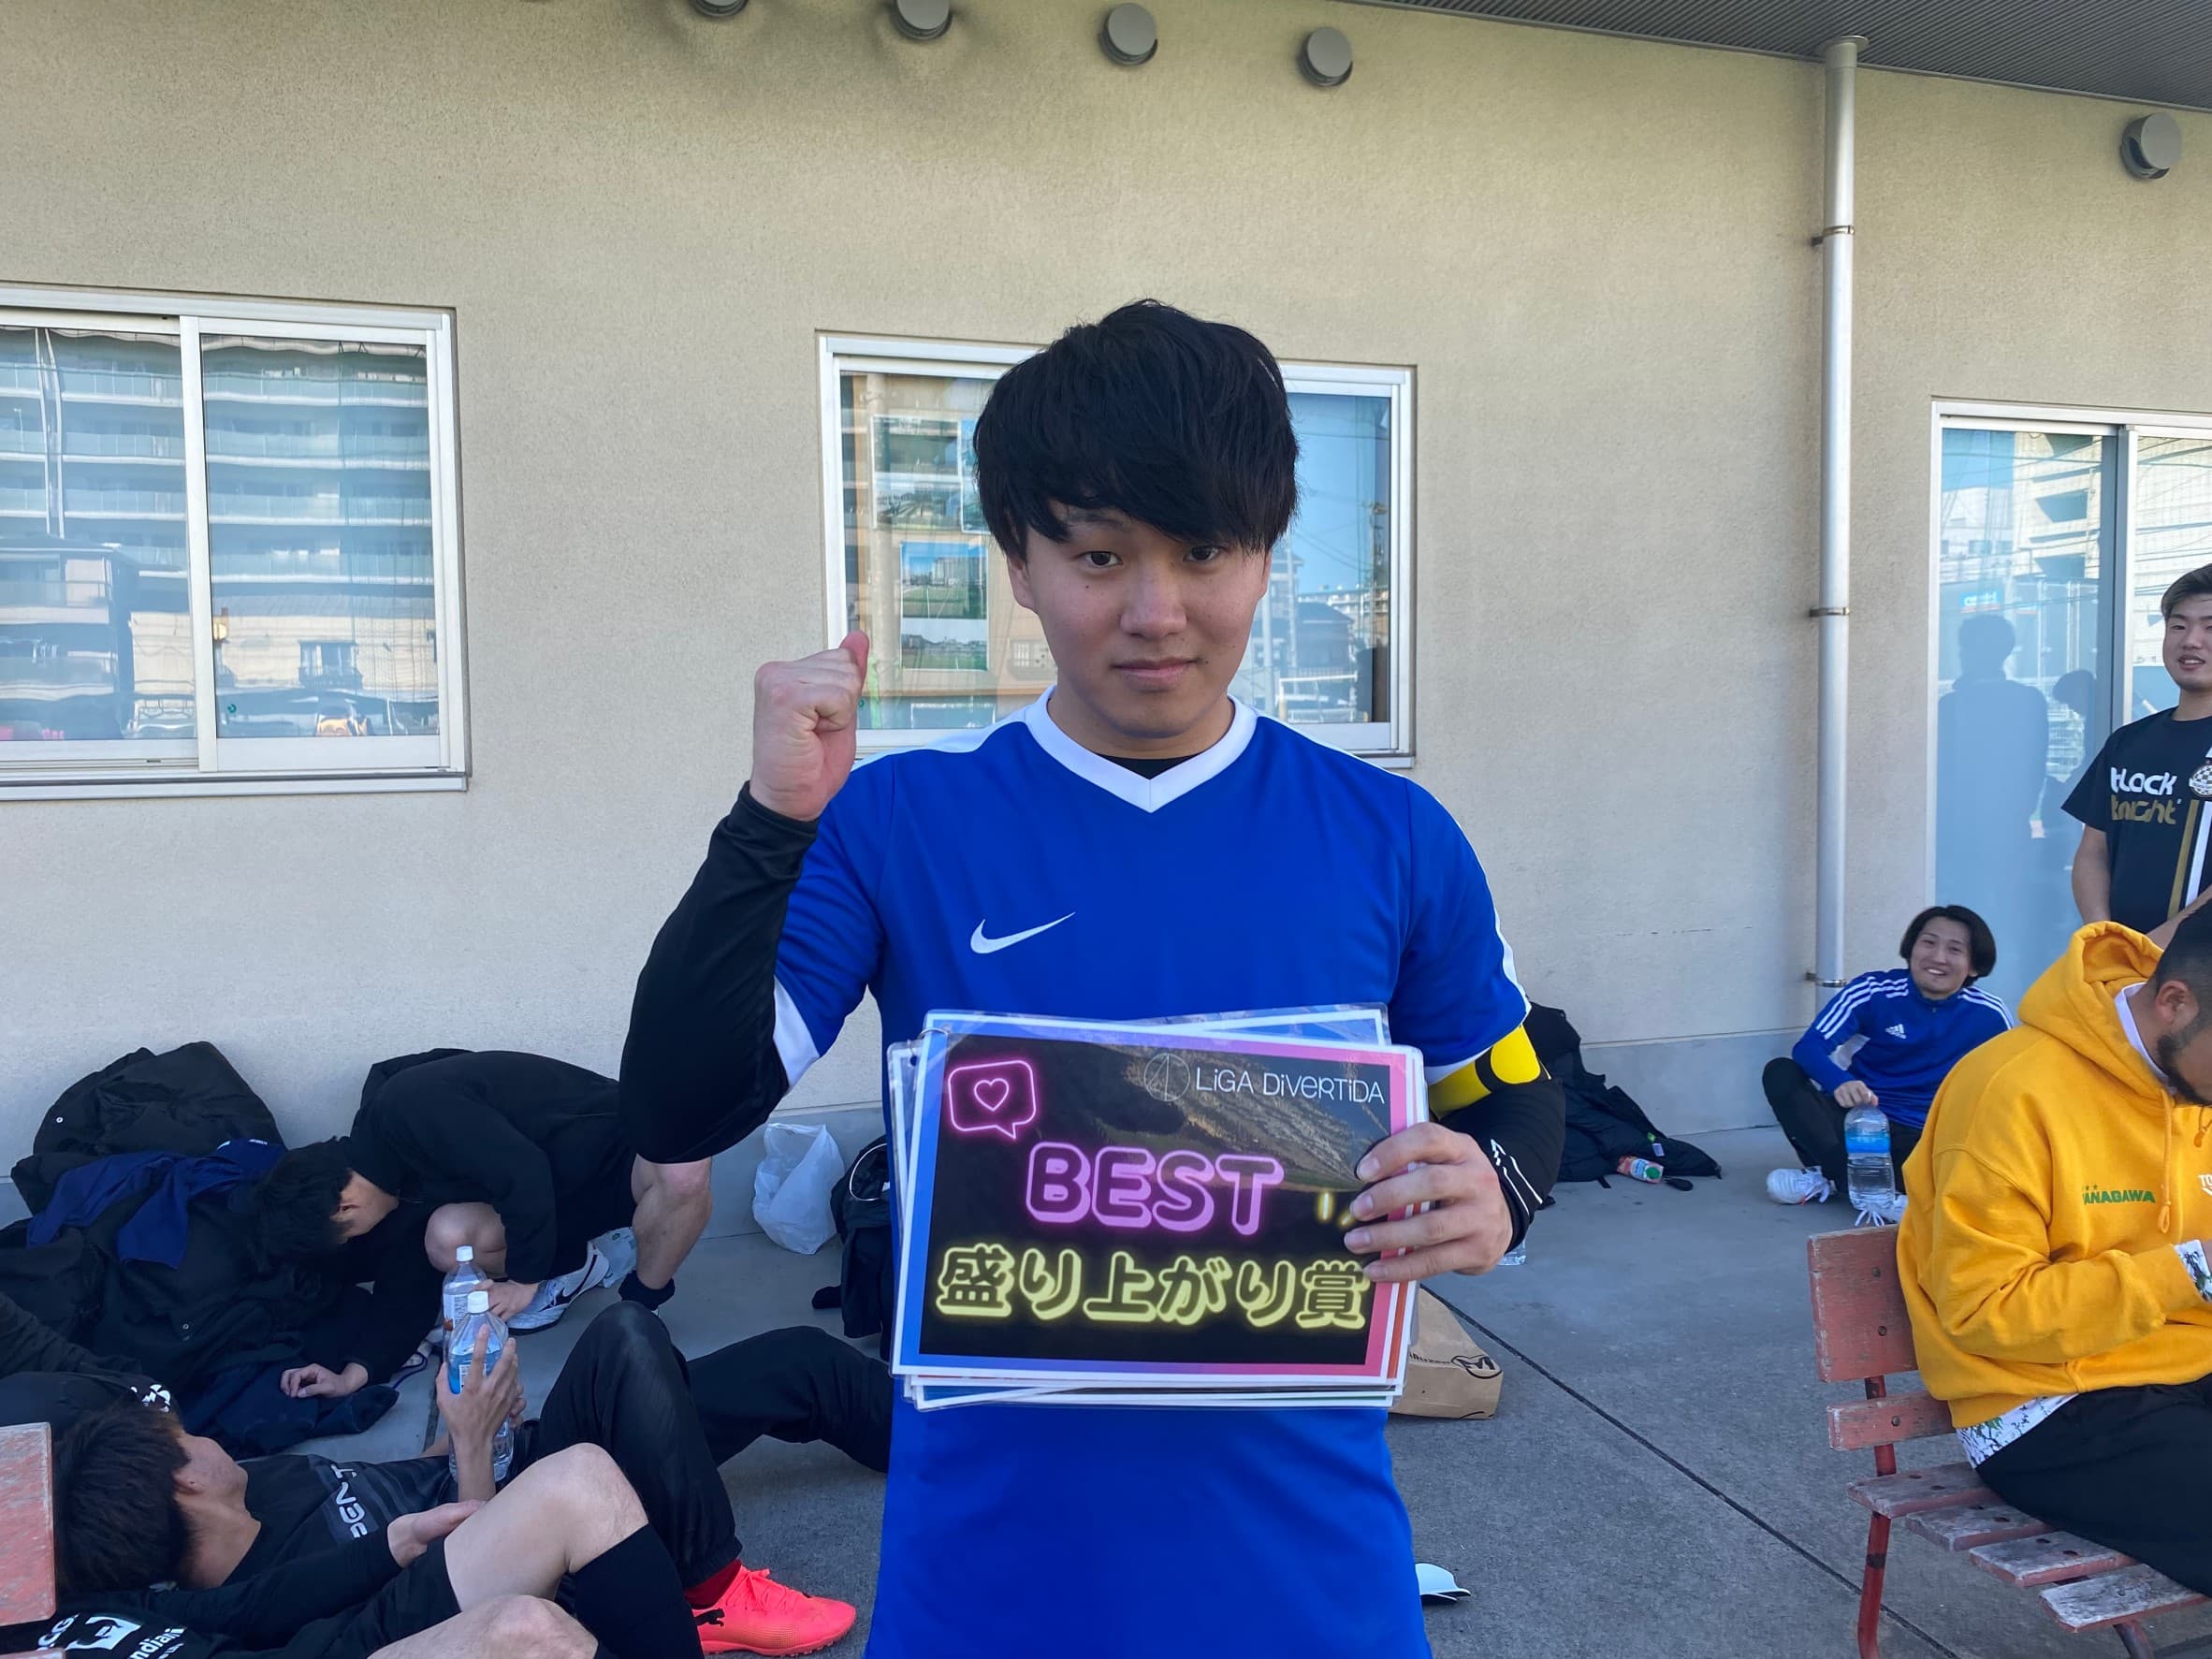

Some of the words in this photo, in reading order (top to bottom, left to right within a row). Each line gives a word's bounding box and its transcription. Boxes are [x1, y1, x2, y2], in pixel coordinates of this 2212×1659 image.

[1026, 1142, 1285, 1235] BEST
[937, 1242, 1370, 1331] 盛り上がり賞
